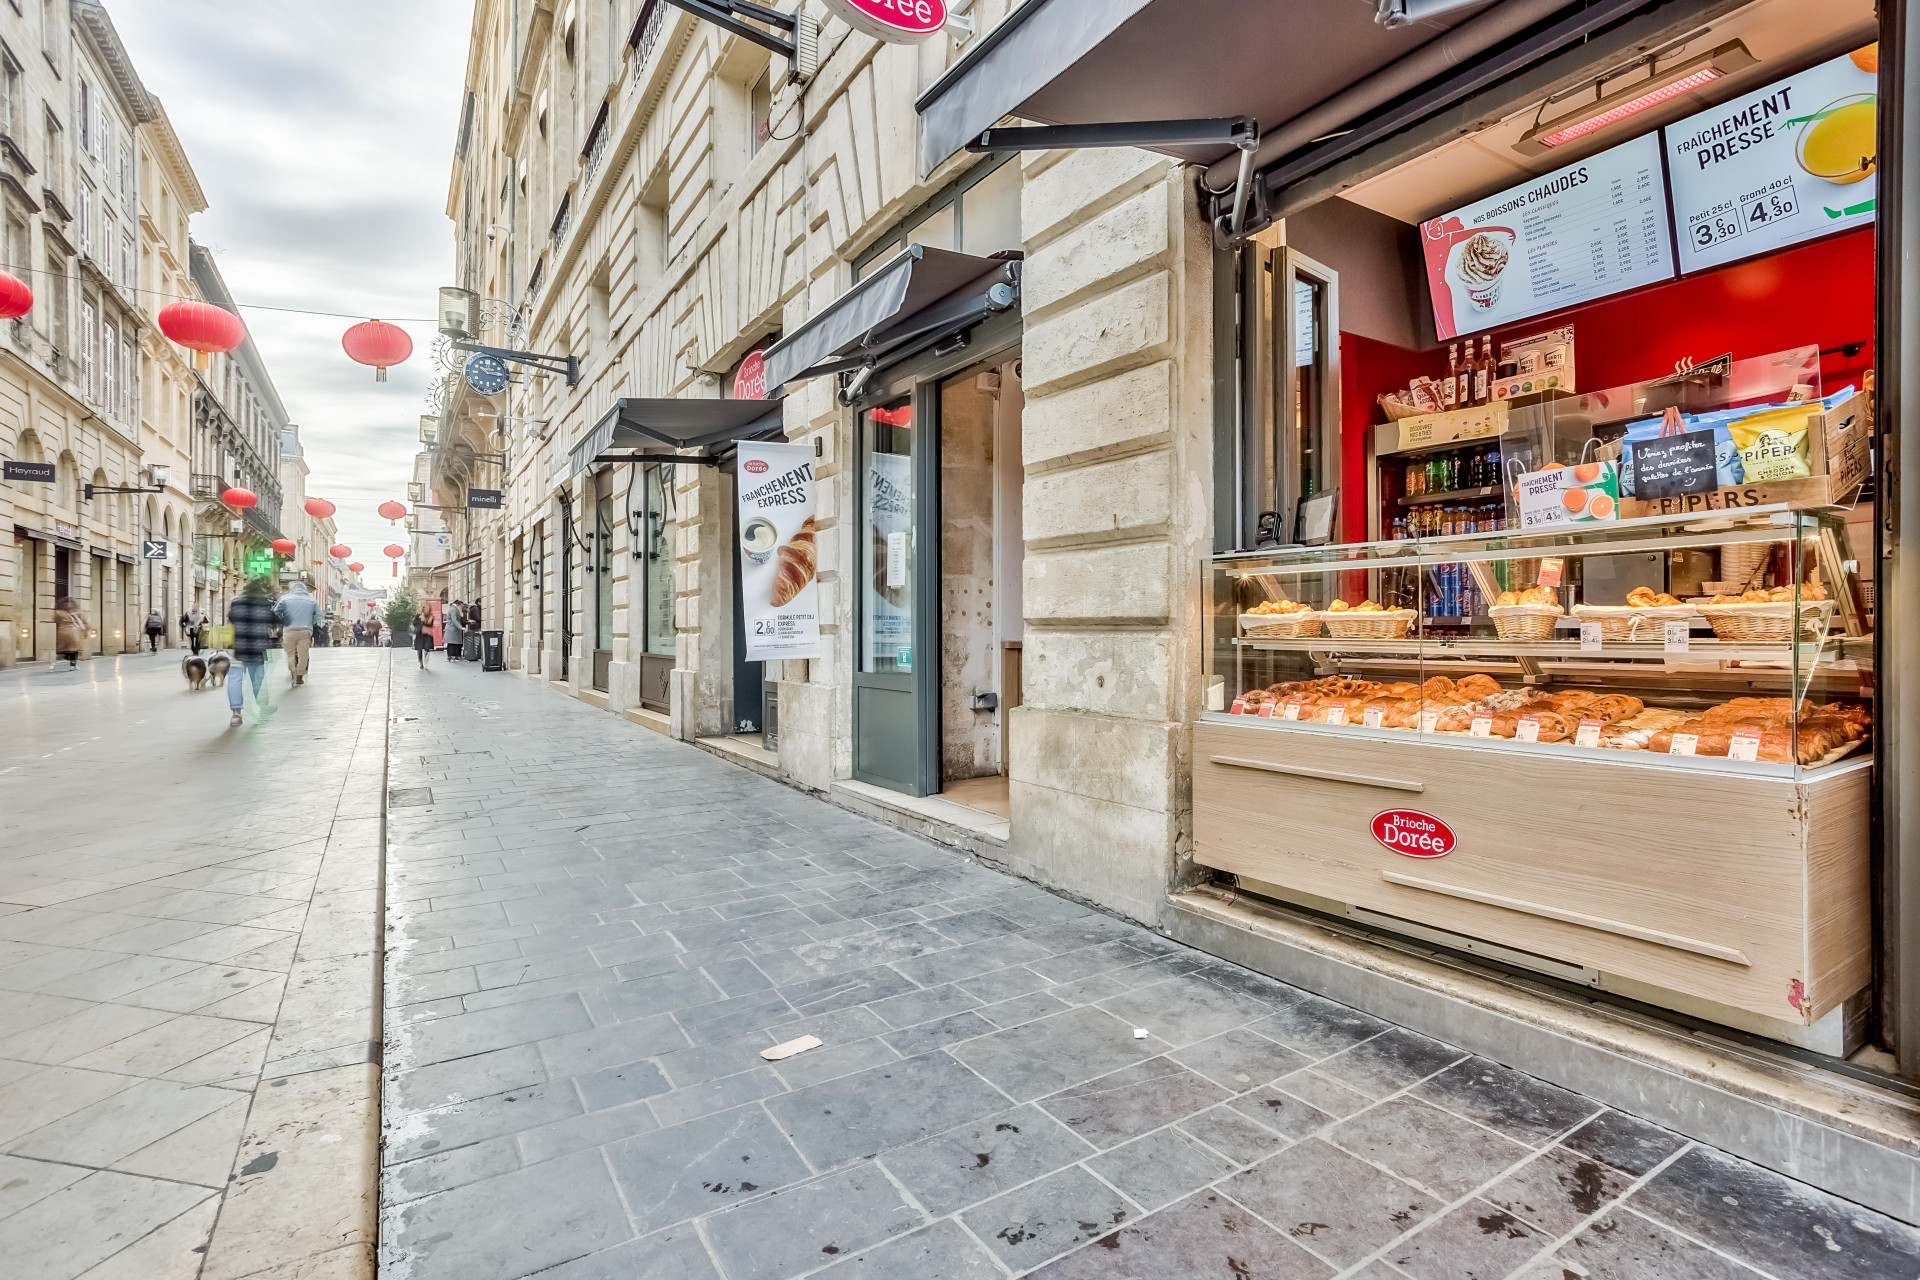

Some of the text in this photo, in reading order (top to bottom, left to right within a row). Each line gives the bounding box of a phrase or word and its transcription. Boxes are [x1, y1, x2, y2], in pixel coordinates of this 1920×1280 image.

[1677, 86, 1792, 154] FRAÎCHEMENT
[1473, 167, 1589, 225] NOS BOISSONS CHAUDES
[1689, 175, 1793, 223] Petit 25 cl Grand 40 cl
[1637, 446, 1668, 460] Venez
[1669, 440, 1706, 457] profiter
[9, 466, 50, 476] Heyraud
[1640, 462, 1655, 472] des
[1672, 465, 1683, 476] de
[1757, 465, 1794, 476] CHEDDAR
[1766, 470, 1794, 478] ONION
[741, 462, 814, 503] FRANCHEMENT
[471, 495, 497, 503] minelli
[758, 487, 808, 509] EXPRESS
[1393, 814, 1436, 832] Brioche
[1383, 823, 1445, 853] Dorée
